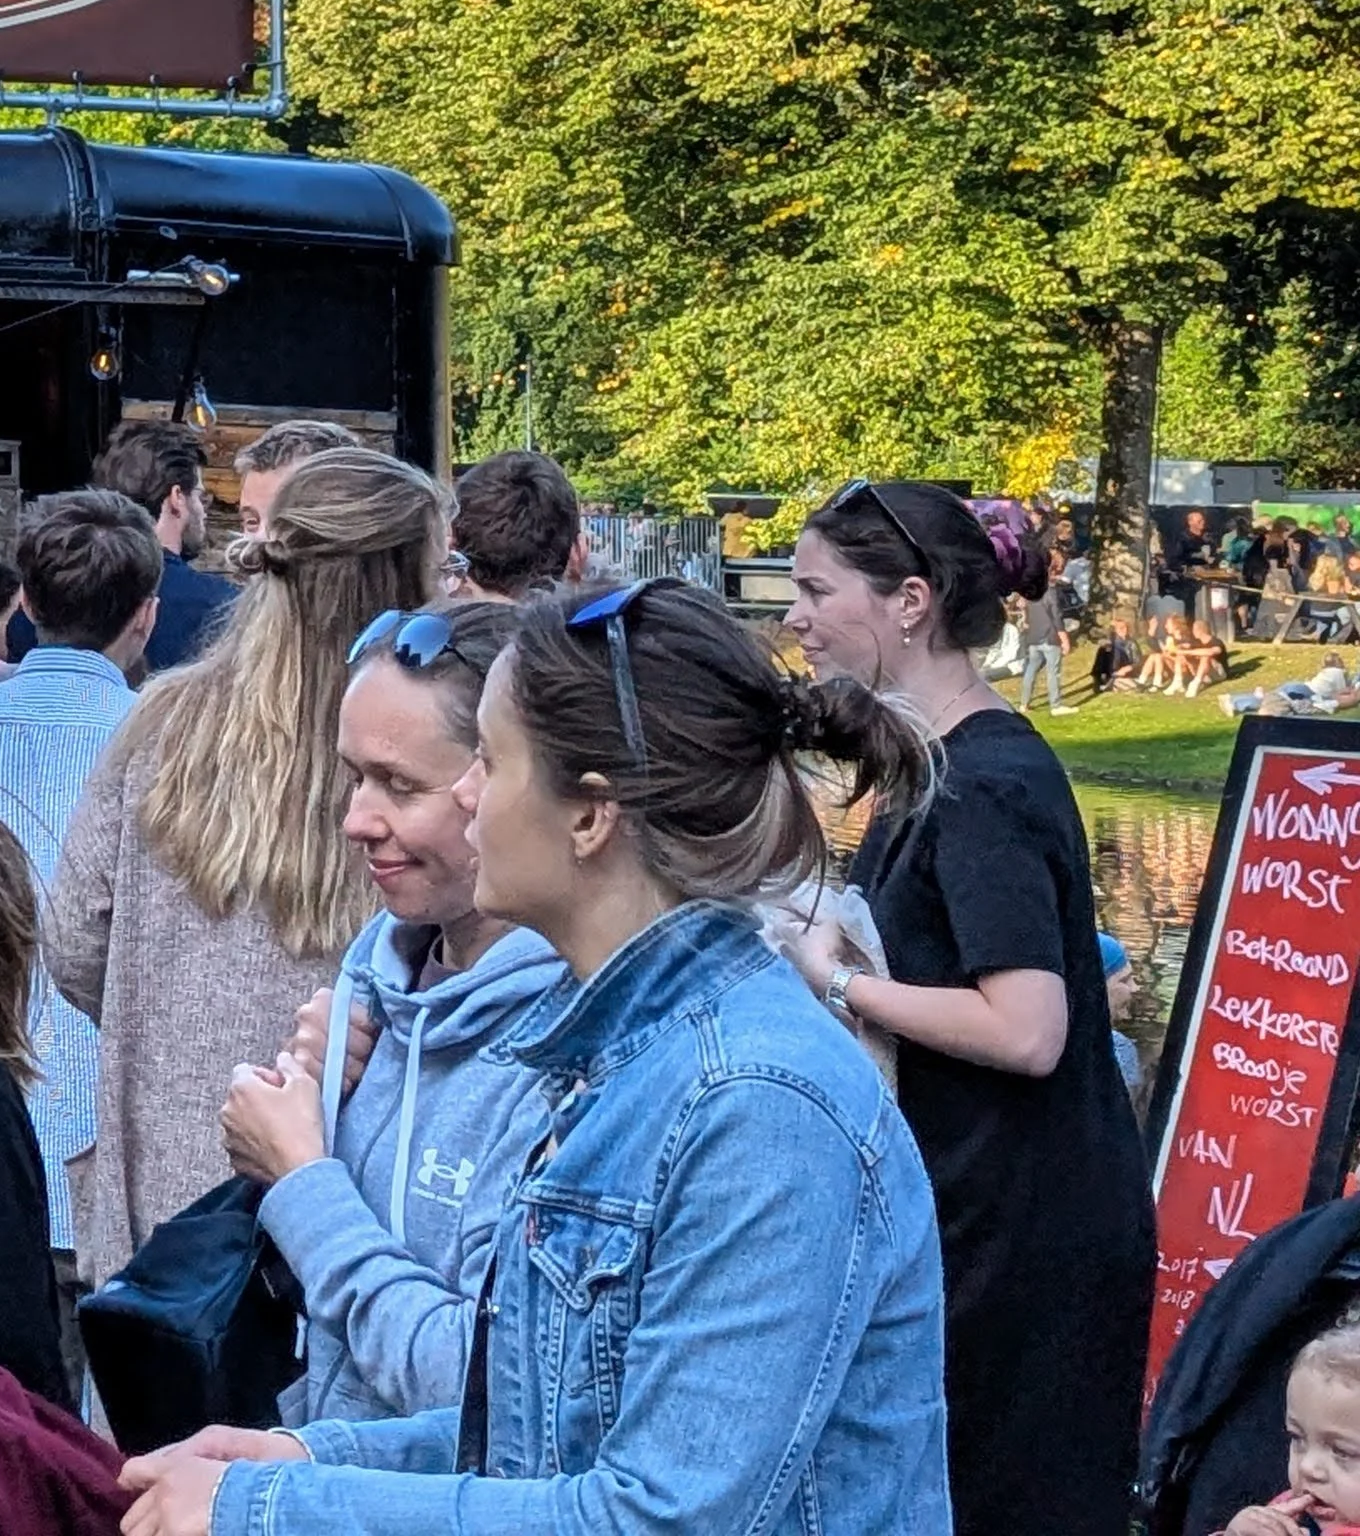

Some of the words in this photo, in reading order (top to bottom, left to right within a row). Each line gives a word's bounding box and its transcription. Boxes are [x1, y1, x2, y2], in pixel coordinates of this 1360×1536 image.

[1230, 1094, 1318, 1128] WORST
[1179, 1130, 1237, 1168] VAN
[1207, 1172, 1259, 1241] NL
[1157, 1251, 1200, 1283] 2017
